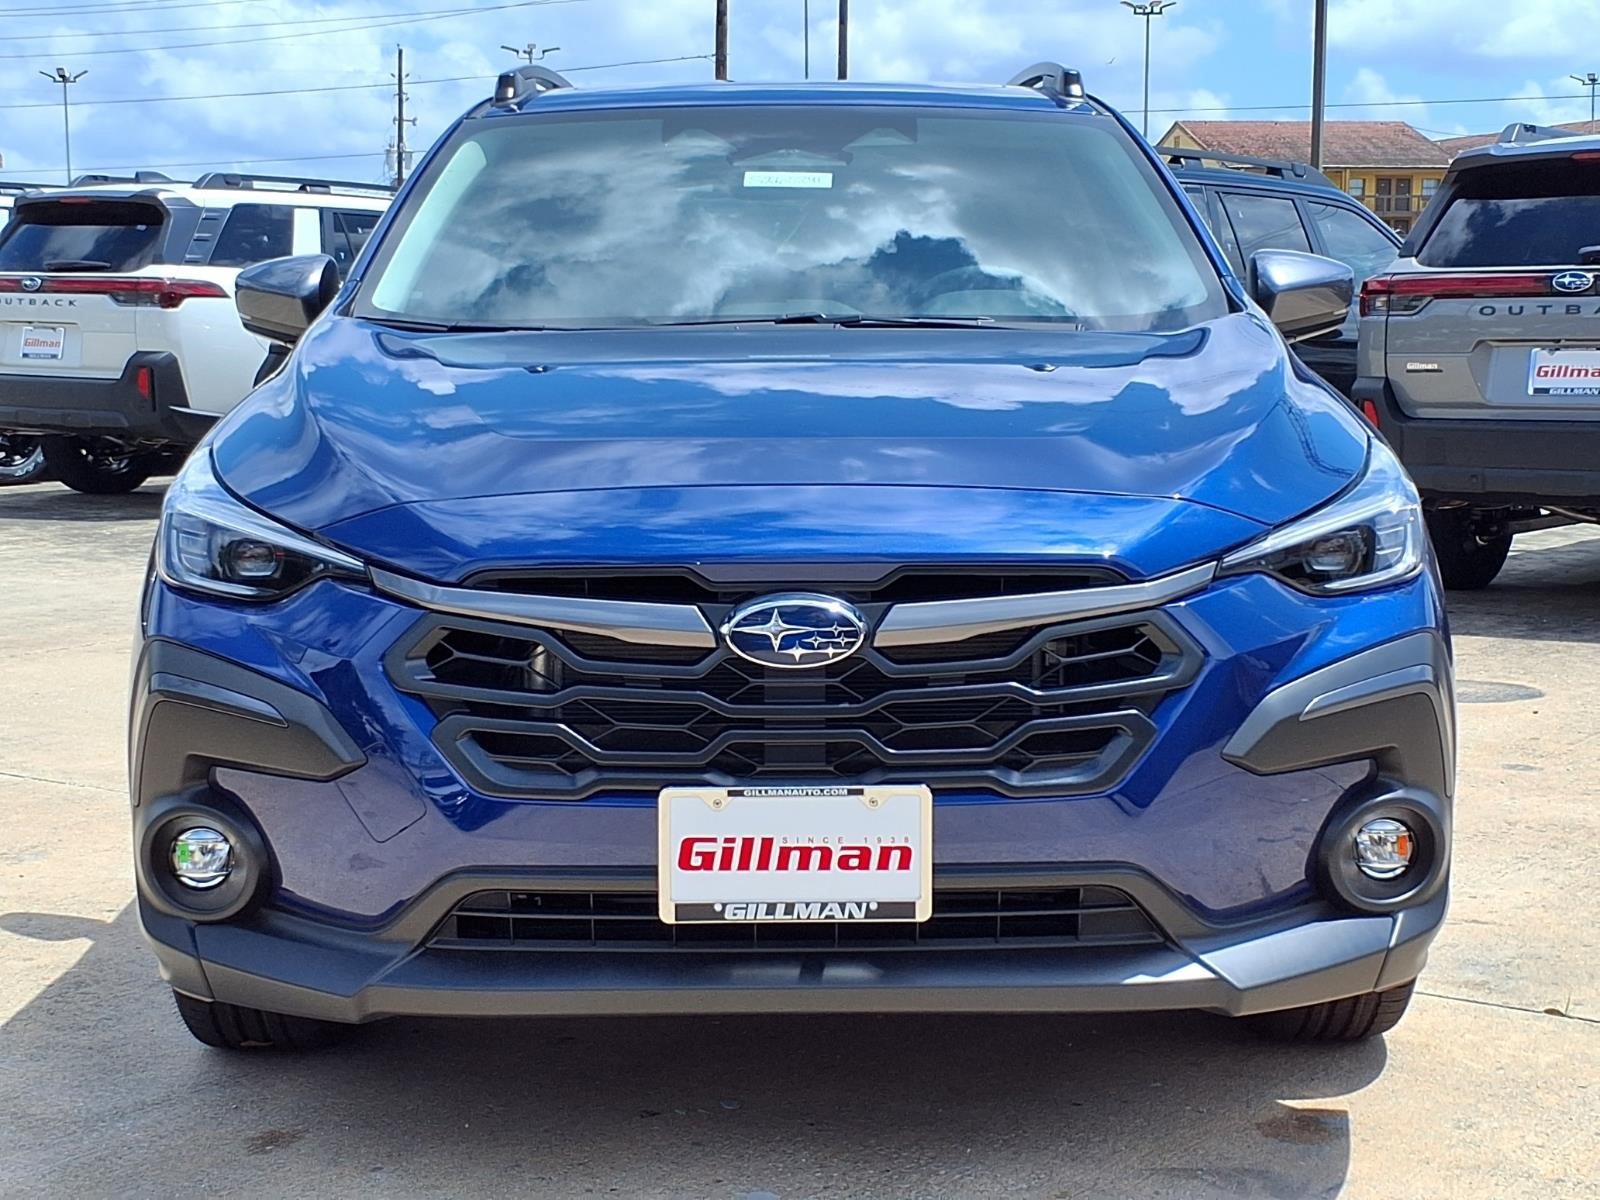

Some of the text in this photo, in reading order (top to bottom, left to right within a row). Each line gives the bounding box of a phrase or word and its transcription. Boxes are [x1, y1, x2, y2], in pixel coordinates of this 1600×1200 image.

[0, 298, 77, 307] UTBACK
[24, 338, 61, 349] Gillman
[743, 788, 848, 796] GILLMANAUTO.COM
[782, 836, 910, 845] SINCE 1938
[677, 836, 913, 872] Gillman
[724, 902, 868, 920] GILLMAN
